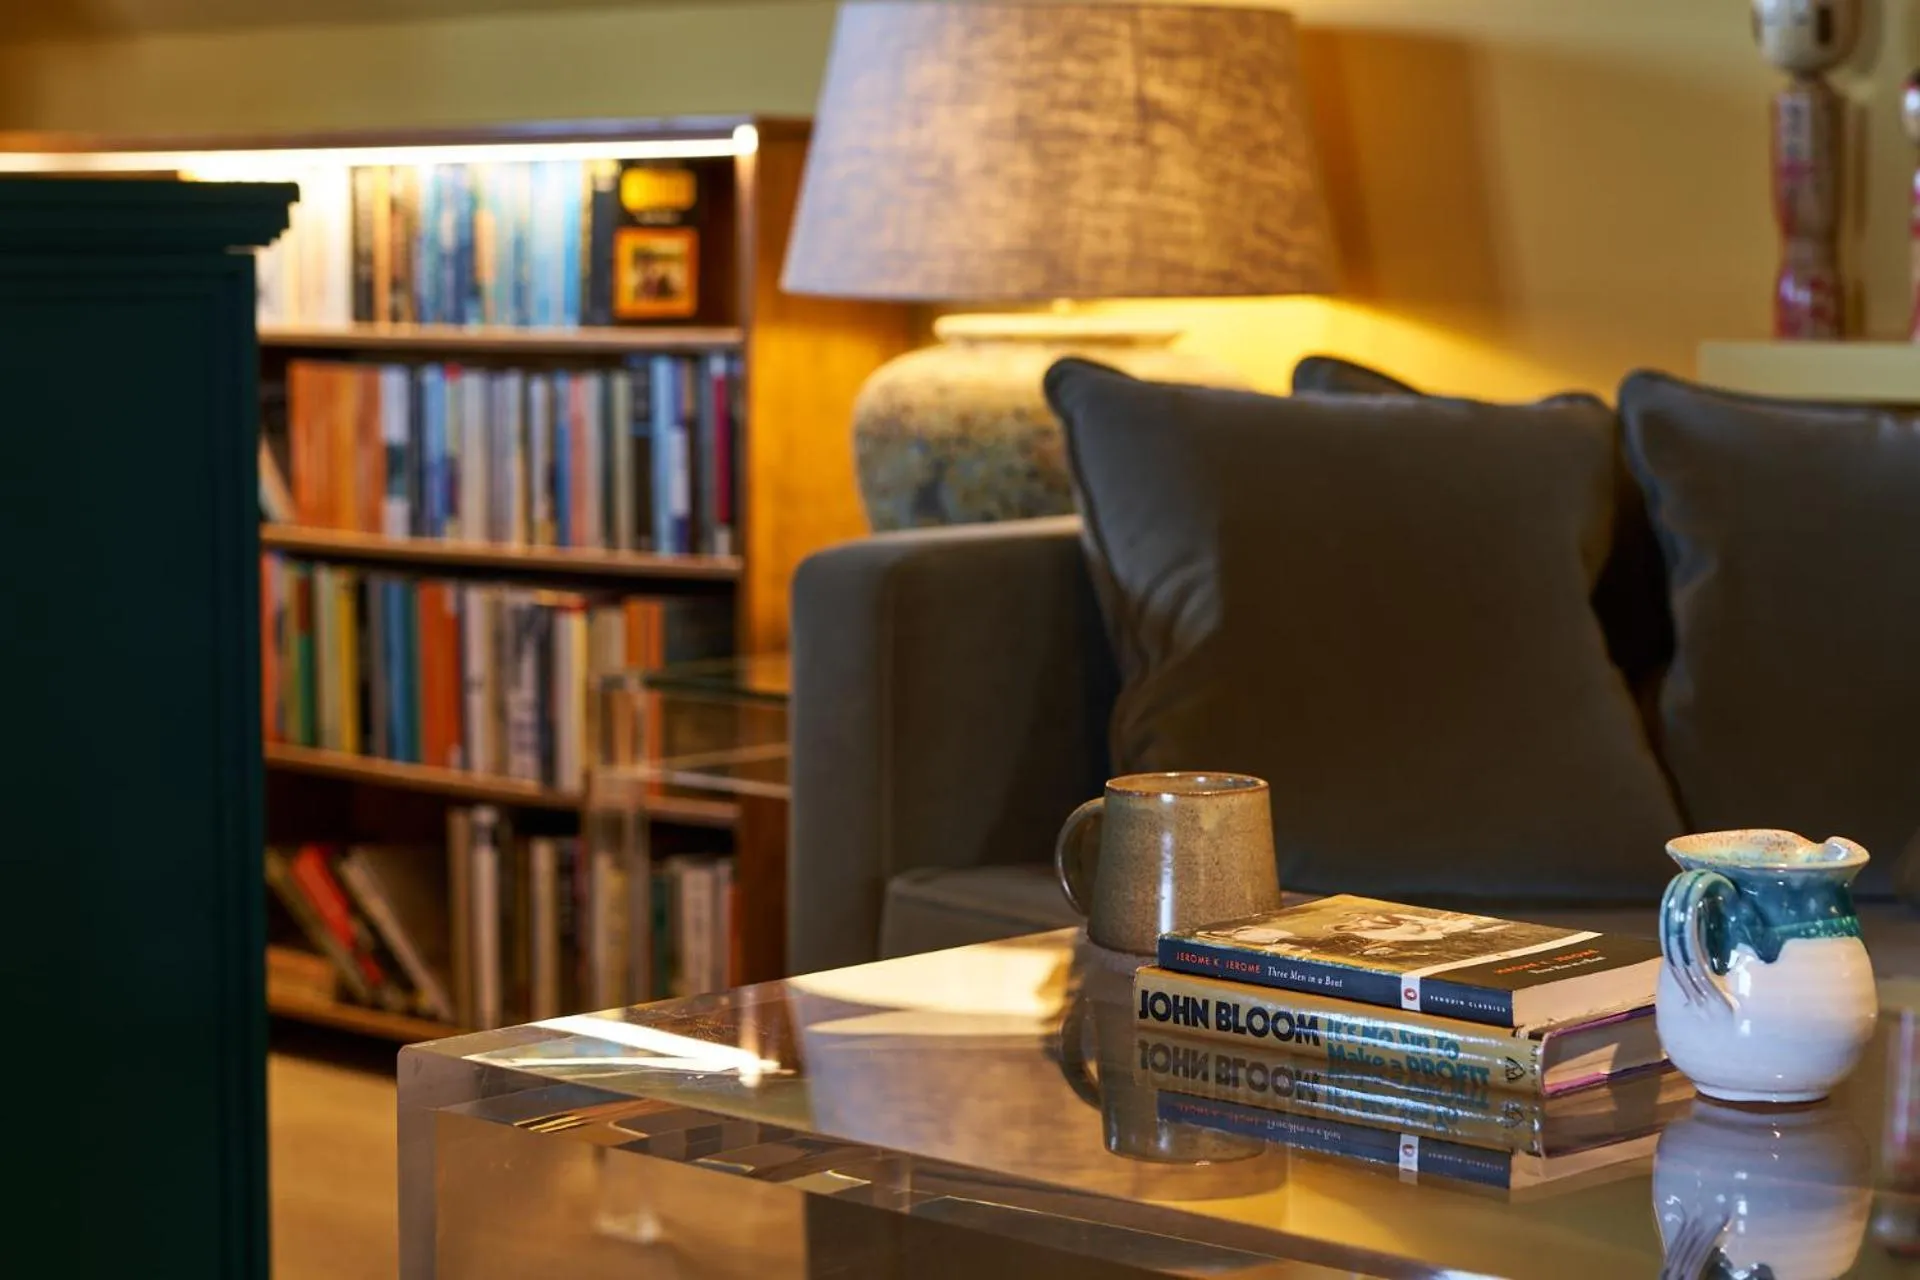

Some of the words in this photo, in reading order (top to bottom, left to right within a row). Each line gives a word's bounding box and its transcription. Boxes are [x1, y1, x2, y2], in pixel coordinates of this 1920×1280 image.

[1176, 952, 1210, 966] JEROME
[1225, 960, 1261, 974] JEROME
[1268, 966, 1288, 979] Three
[1289, 970, 1306, 983] Men
[1307, 975, 1316, 984] in
[1325, 975, 1343, 988] Boat
[1138, 989, 1210, 1030] JOHN
[1215, 1001, 1321, 1046] BLOOM
[1468, 1001, 1506, 1013] CLASSICS
[1327, 1042, 1385, 1067] Make
[1406, 1055, 1490, 1086] PROFIT
